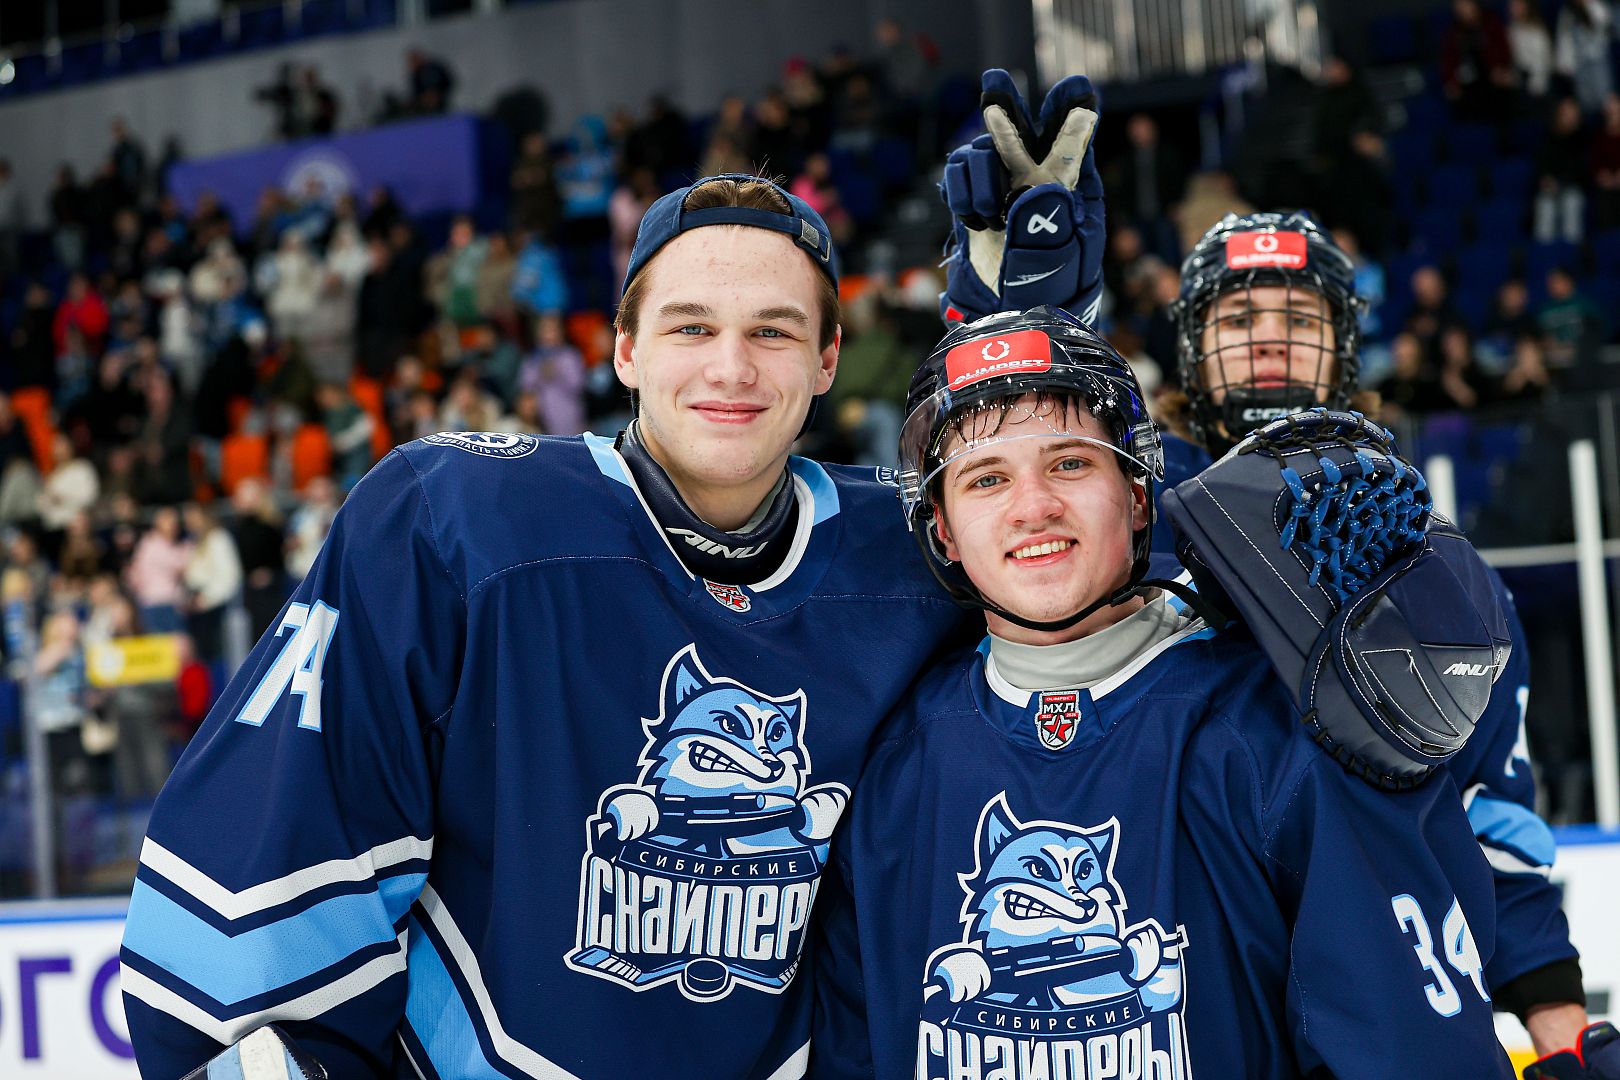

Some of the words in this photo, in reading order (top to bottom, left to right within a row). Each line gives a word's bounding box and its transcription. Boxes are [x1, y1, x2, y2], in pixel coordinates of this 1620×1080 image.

[954, 359, 1045, 385] OLIMPBET
[1043, 702, 1075, 714] МХЛ
[639, 851, 798, 876] СИБИРСКИЕ
[585, 855, 821, 961] СНАЙПЕР
[1391, 893, 1492, 1018] 34
[977, 1006, 1131, 1030] СИБИРСКИЕ
